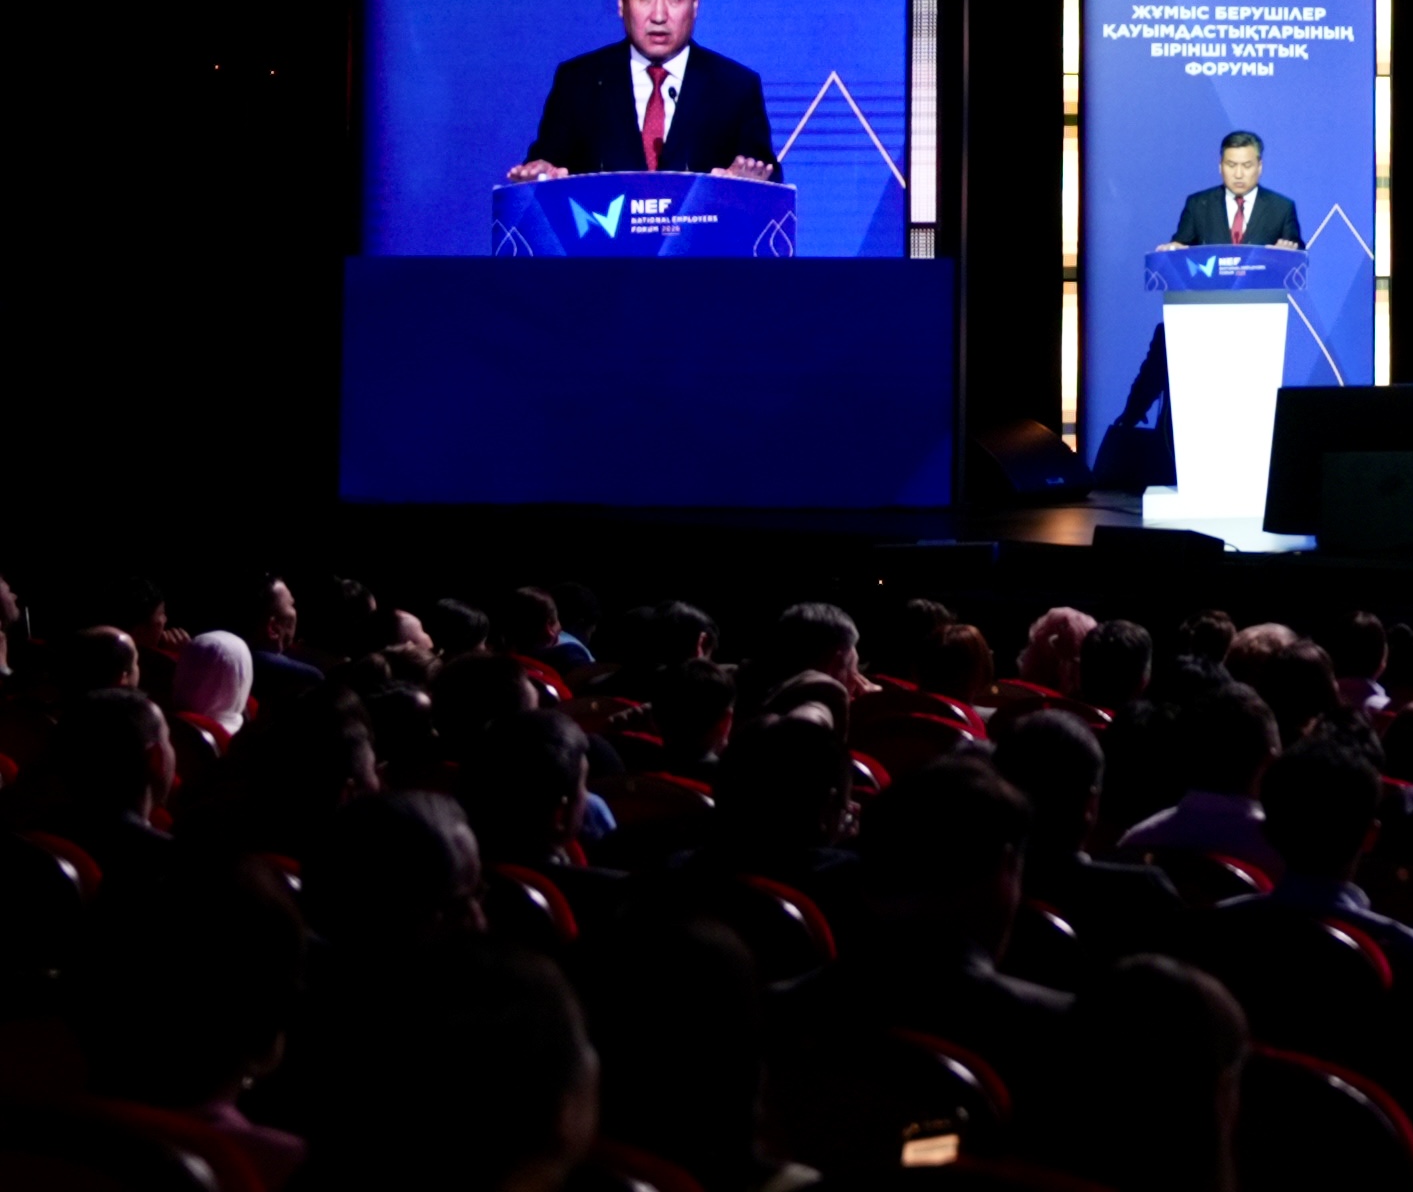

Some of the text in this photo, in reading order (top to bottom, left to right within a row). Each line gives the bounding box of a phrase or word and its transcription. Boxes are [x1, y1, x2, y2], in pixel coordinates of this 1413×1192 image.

[1131, 5, 1327, 21] ЖҰМЫС БЕРУШІЛЕР
[1102, 23, 1355, 42] ҚАУЫМДАСТЫҚТАРЫНЫҢ
[1150, 43, 1309, 60] БІРІНШІ ҰЛТТЫҚ
[1185, 61, 1274, 77] ФОРУМЫ
[631, 198, 672, 215] NEF
